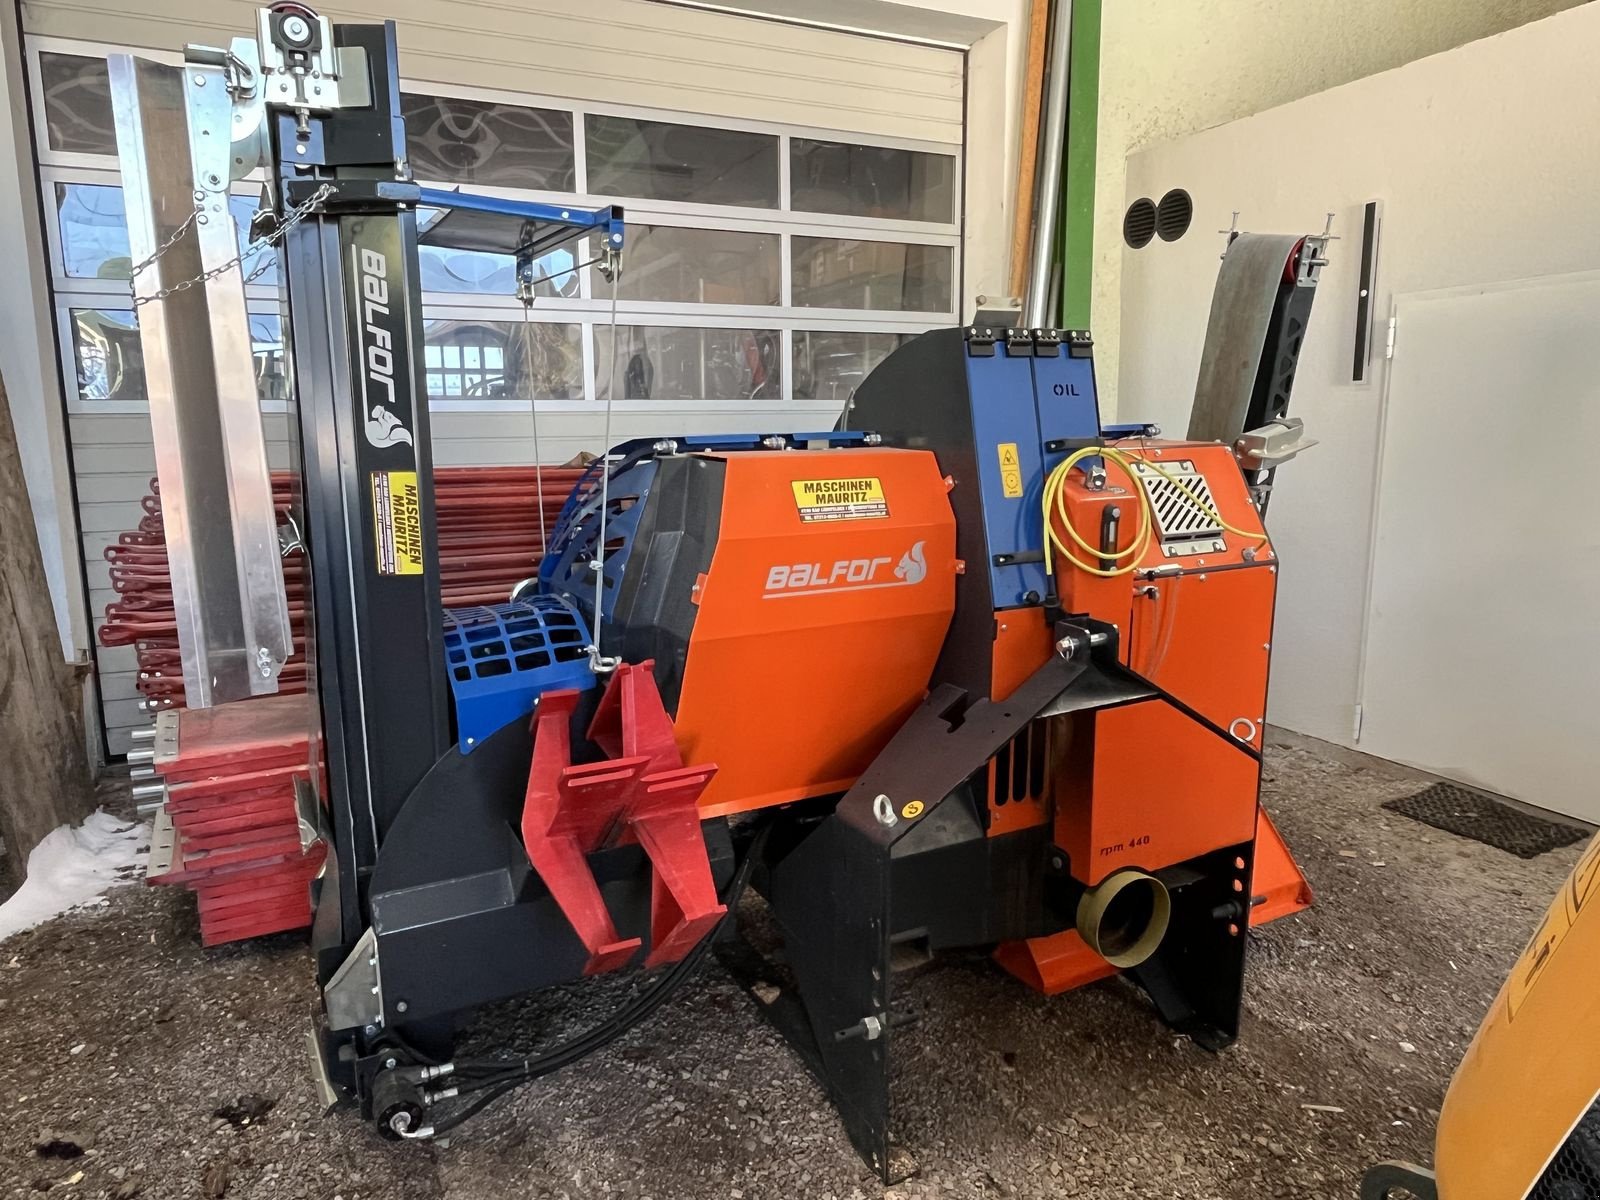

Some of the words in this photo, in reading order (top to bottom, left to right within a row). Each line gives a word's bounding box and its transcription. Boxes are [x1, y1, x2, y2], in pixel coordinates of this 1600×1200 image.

[1053, 383, 1080, 396] OIL
[804, 480, 873, 494] MASCHINEN
[816, 492, 867, 505] MAURITZ
[393, 494, 408, 556] MAURITZ
[405, 484, 422, 565] MASCHINEN
[1100, 843, 1124, 857] rpm
[1128, 835, 1150, 848] 440
